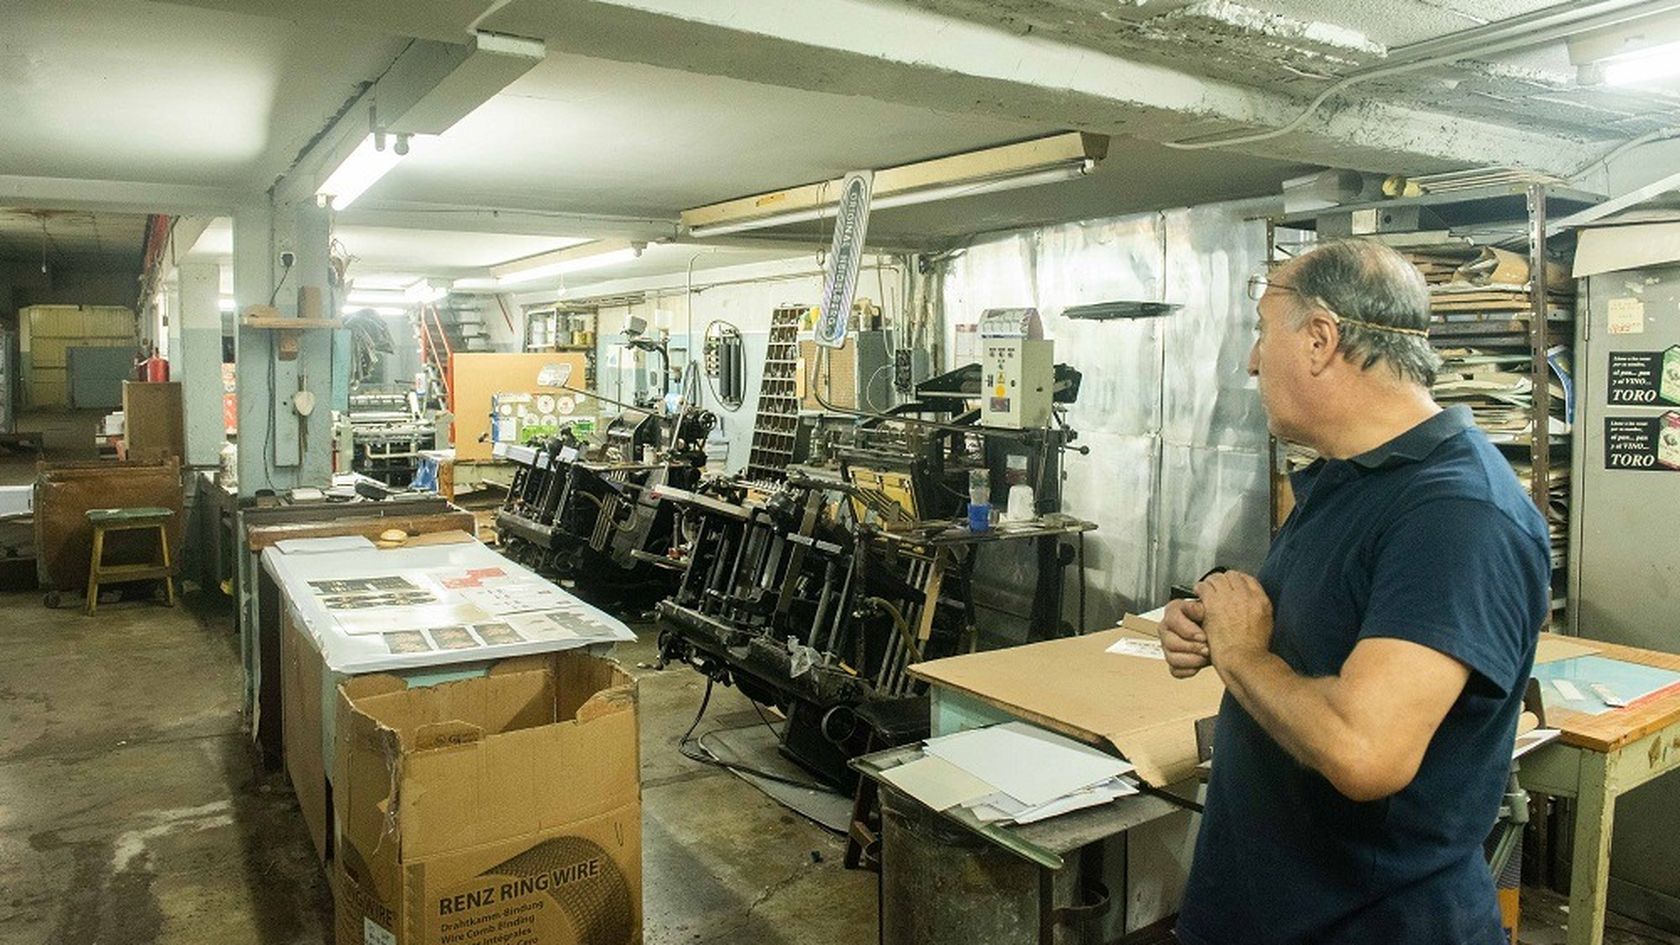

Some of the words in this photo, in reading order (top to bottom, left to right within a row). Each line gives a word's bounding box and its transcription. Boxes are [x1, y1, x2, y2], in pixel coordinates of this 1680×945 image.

[843, 192, 857, 244] ORIGINAL
[828, 255, 849, 325] HEIDELBERG
[1612, 389, 1657, 402] TORO
[1611, 453, 1655, 467] TORO
[440, 888, 494, 915] RENZ
[501, 875, 548, 901] RING
[553, 859, 599, 886] WIRE
[441, 934, 464, 944] Wire
[466, 925, 496, 939] Comb
[498, 915, 535, 930] Binding
